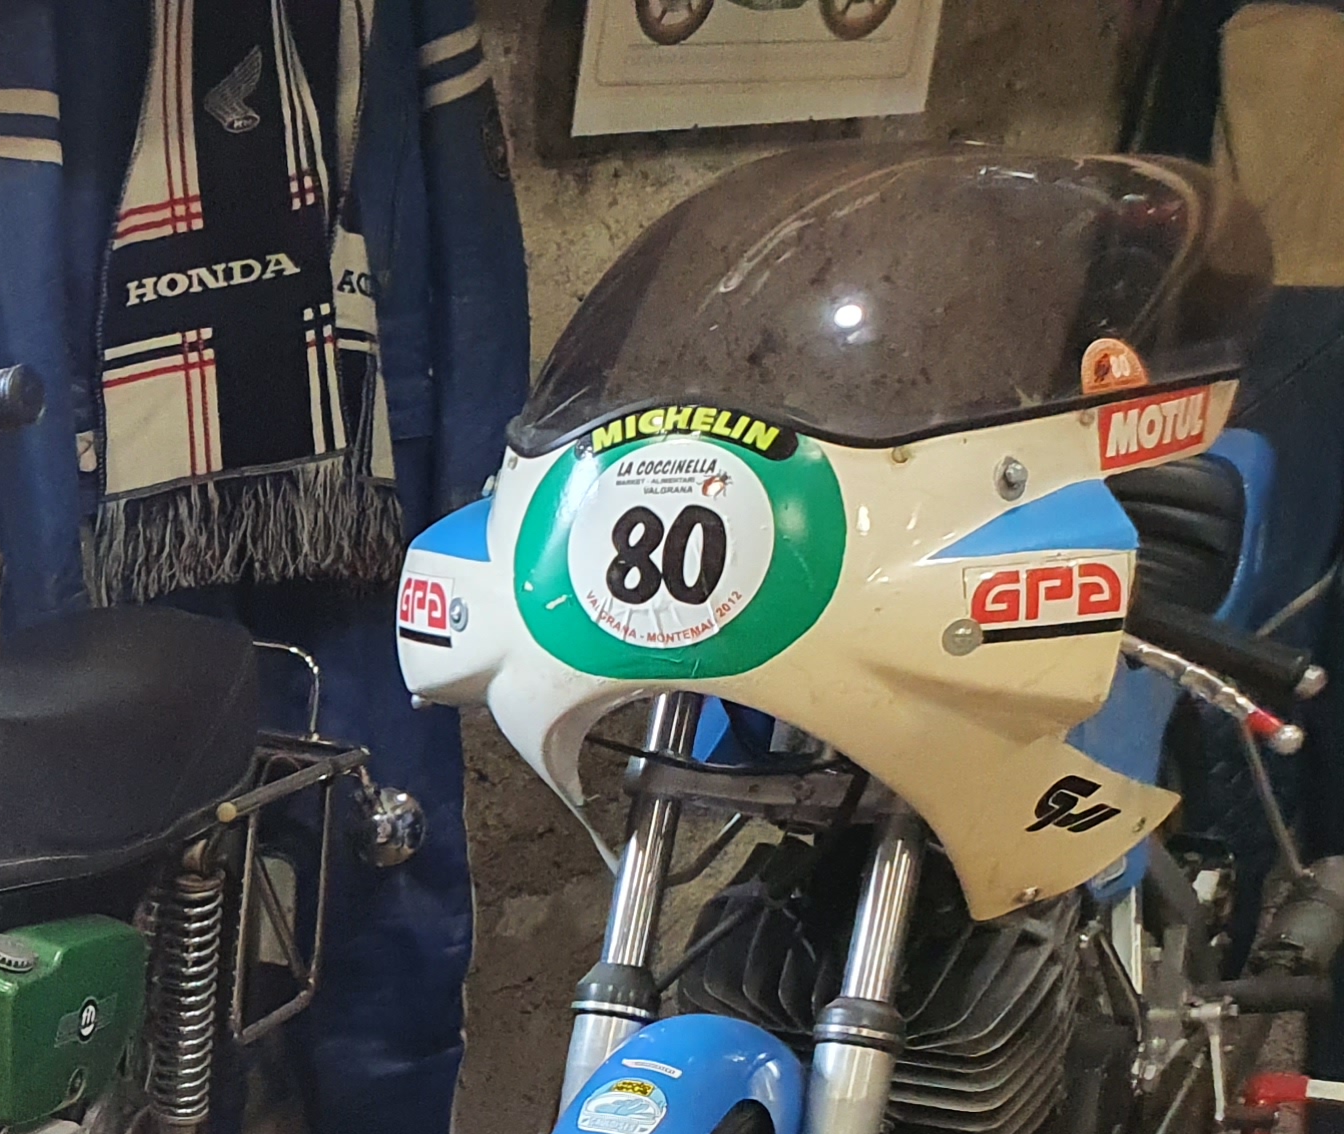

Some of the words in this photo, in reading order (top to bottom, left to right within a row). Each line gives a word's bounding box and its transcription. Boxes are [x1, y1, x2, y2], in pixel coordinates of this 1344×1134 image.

[126, 253, 301, 307] HONDA
[591, 406, 780, 452] MICHELIN
[1106, 392, 1205, 458] MOTUL
[617, 461, 634, 477] LA
[636, 458, 718, 475] COCCINELLA
[606, 504, 727, 605] 80
[715, 590, 743, 618] 2012
